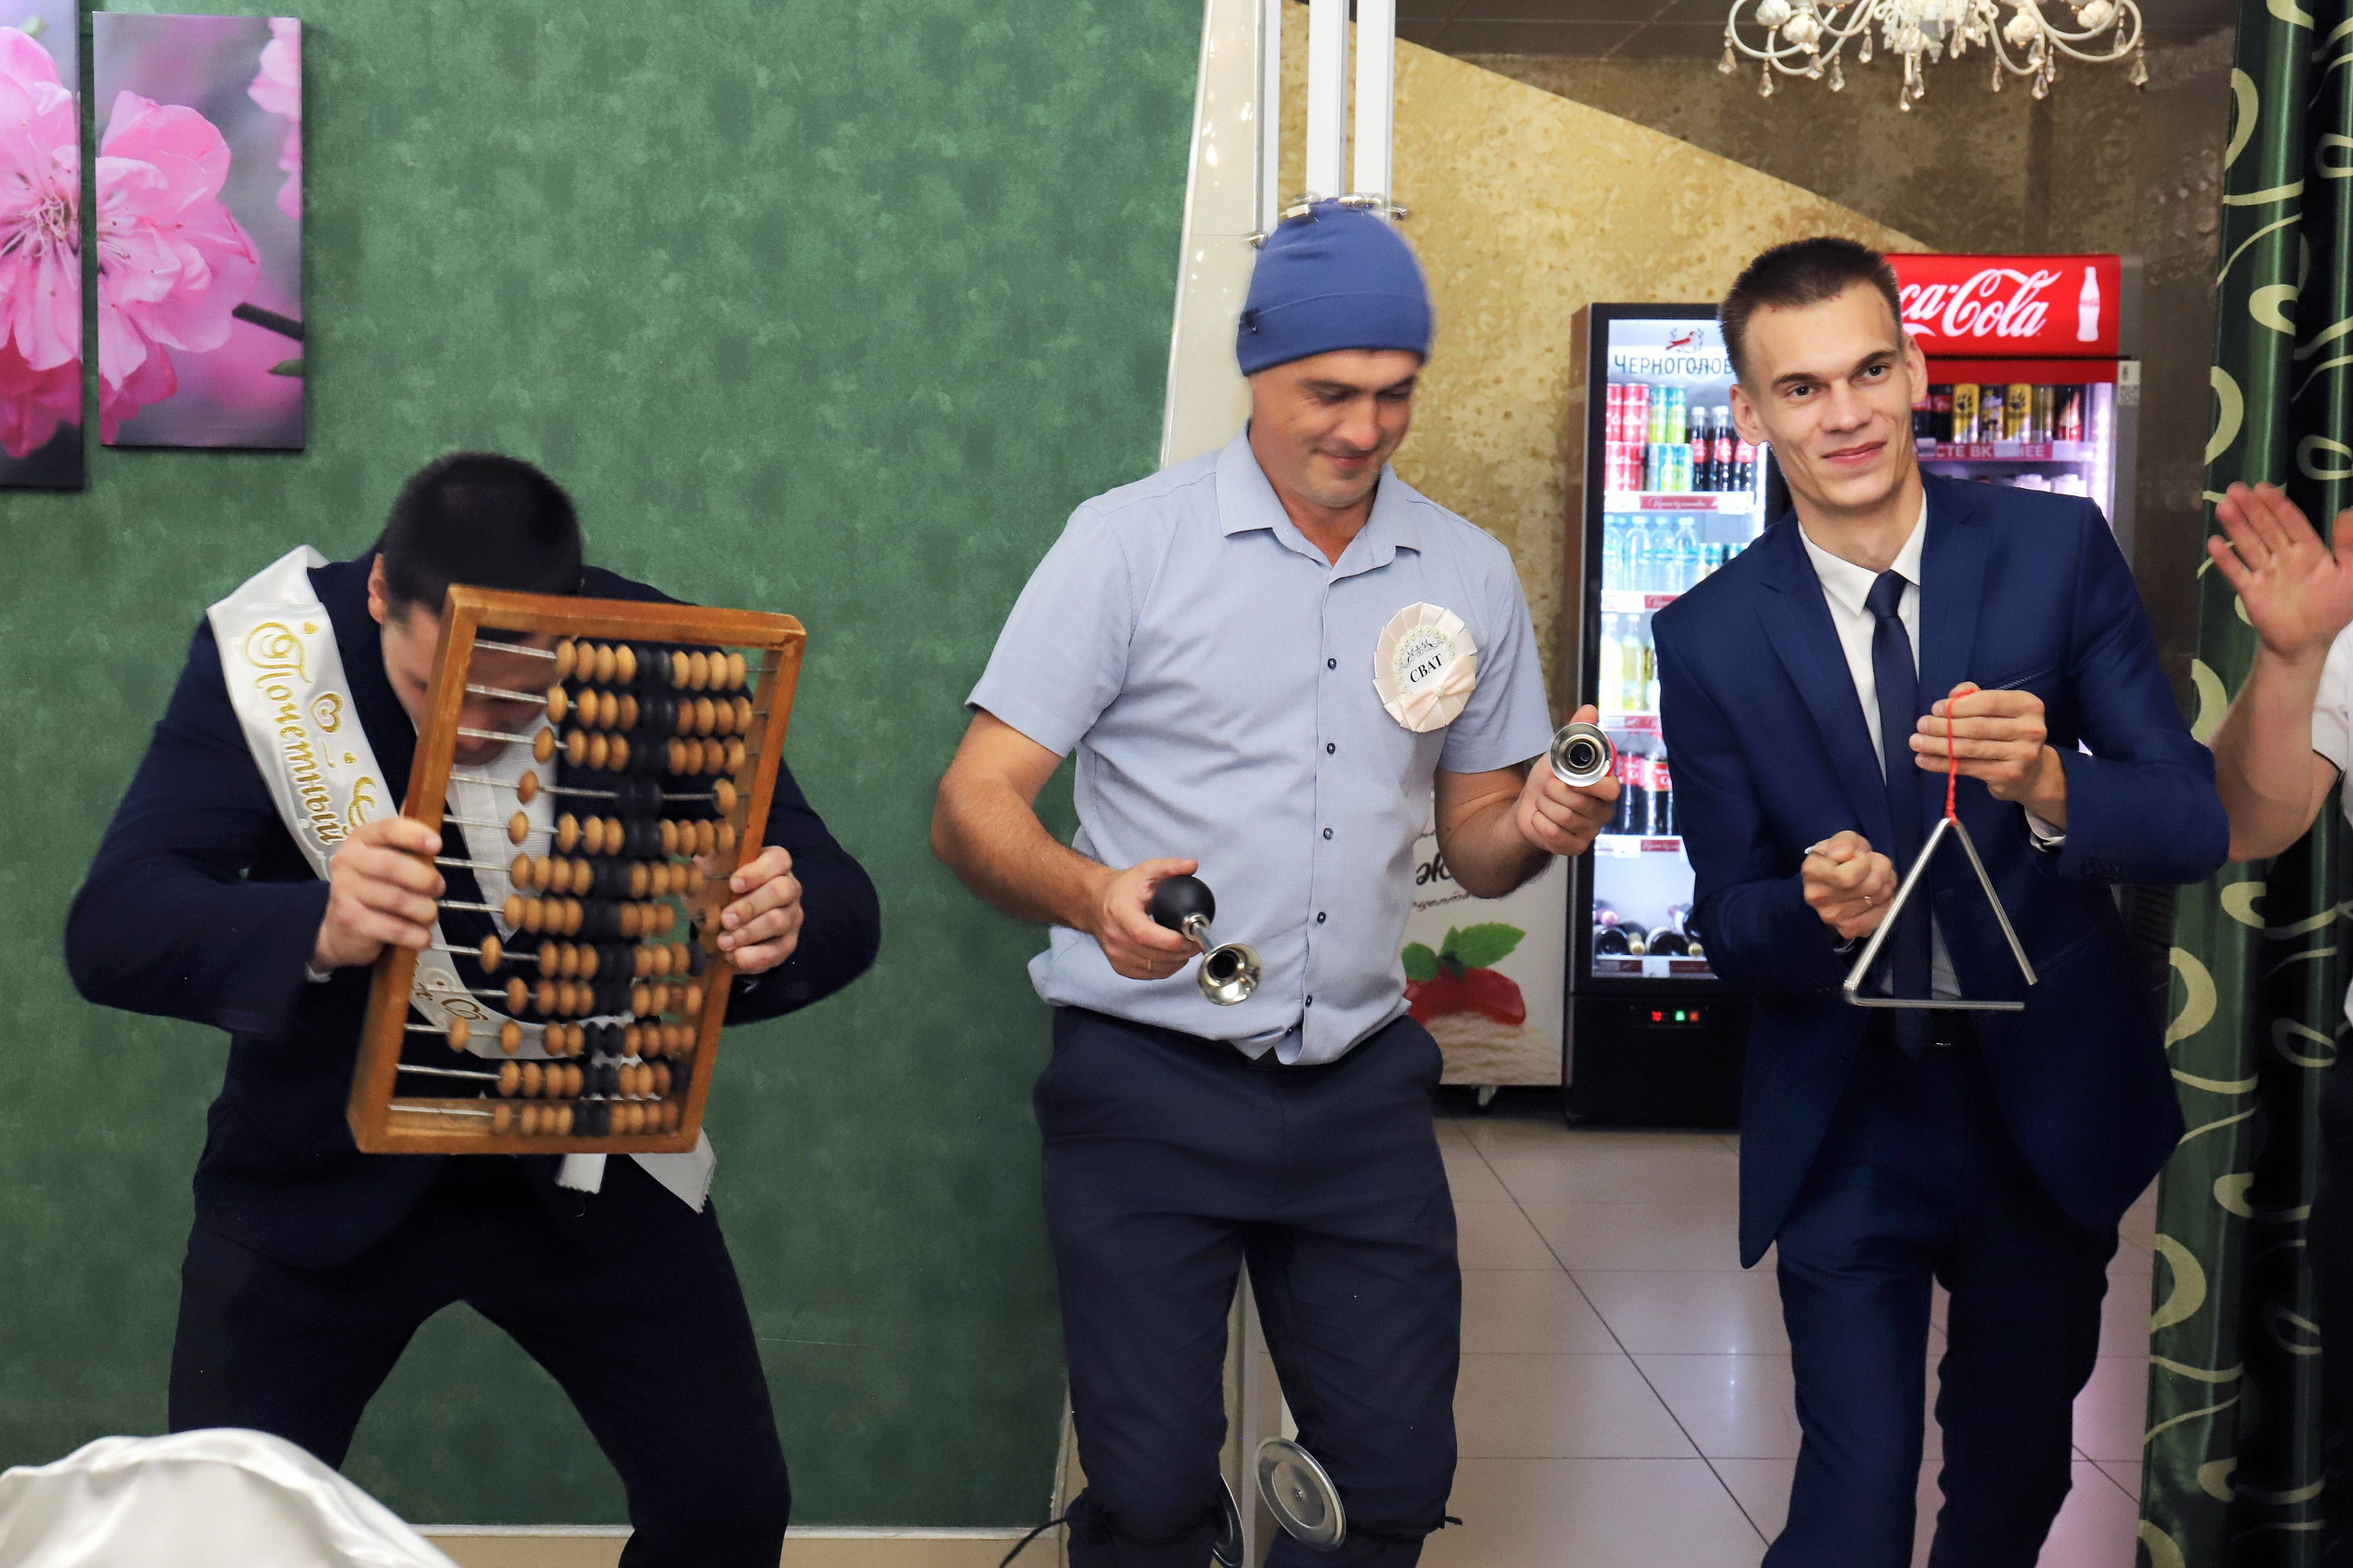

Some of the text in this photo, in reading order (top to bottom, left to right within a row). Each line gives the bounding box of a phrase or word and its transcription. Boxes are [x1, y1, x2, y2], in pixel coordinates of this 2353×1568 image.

[1901, 268, 2063, 338] ca-Cola
[1614, 354, 1732, 375] ЧЕРНОГОЛОВ
[1409, 653, 1443, 684] СВАТ
